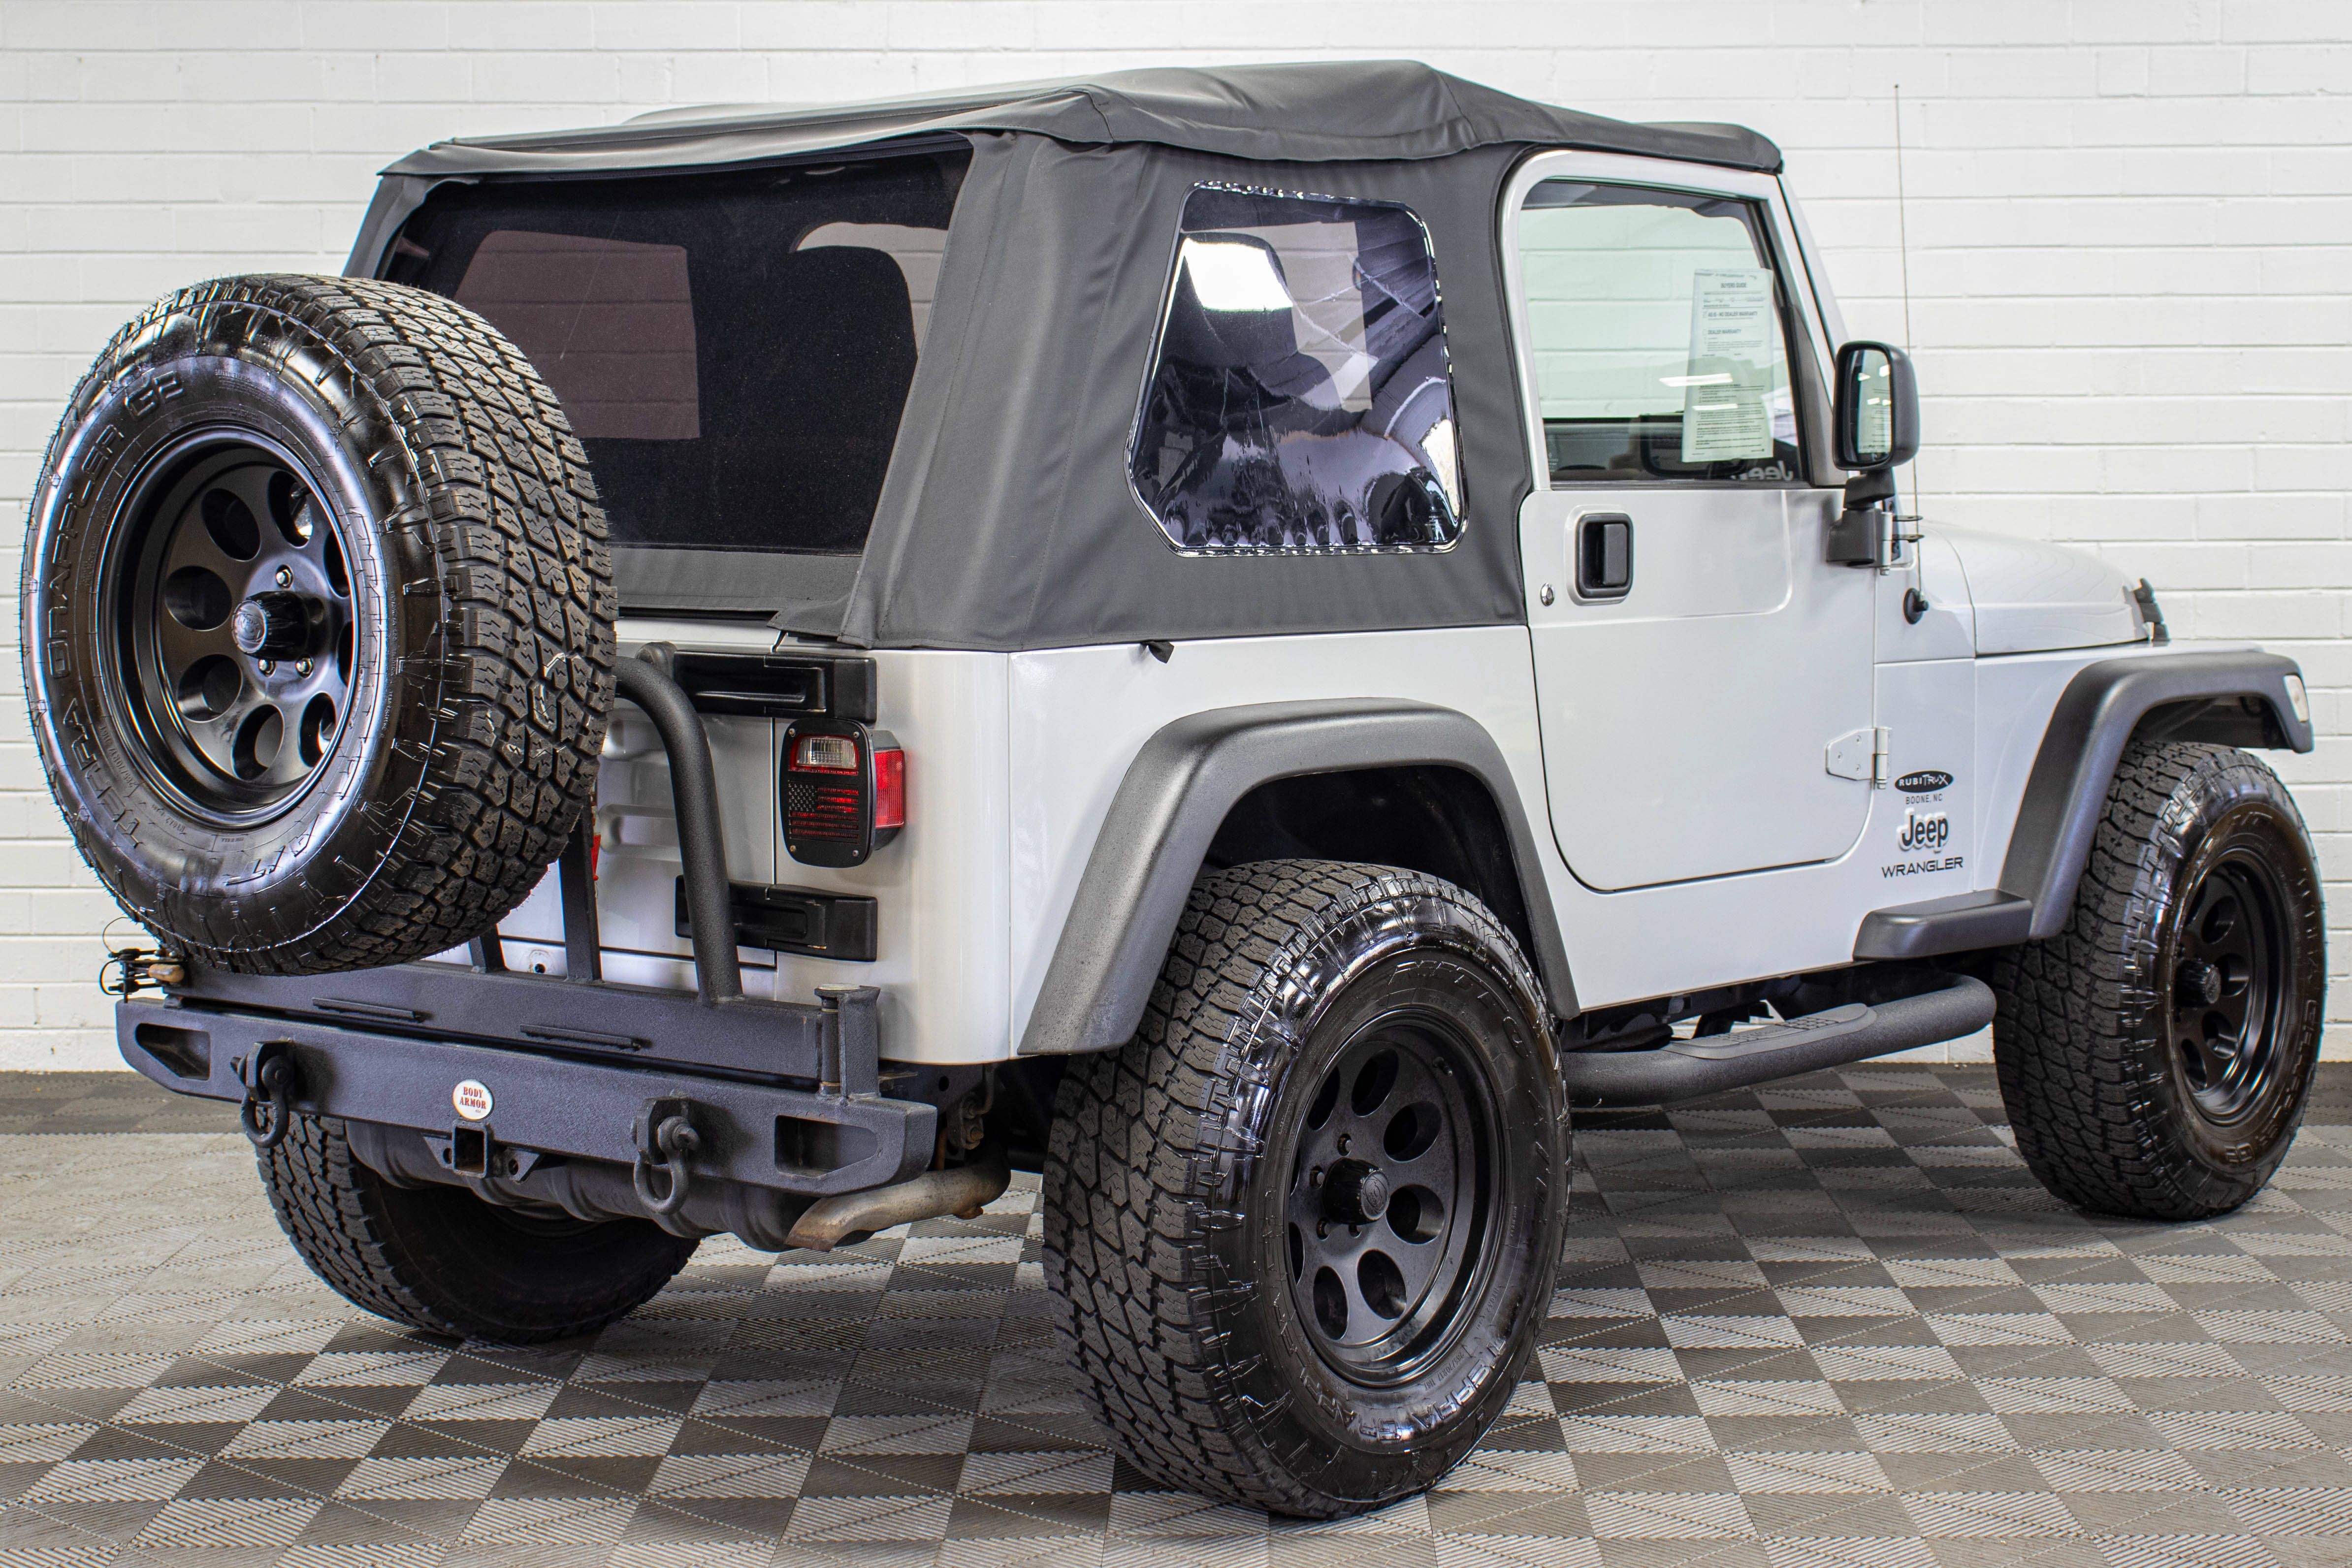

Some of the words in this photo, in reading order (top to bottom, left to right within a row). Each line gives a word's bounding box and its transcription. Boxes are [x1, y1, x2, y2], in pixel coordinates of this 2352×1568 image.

[1905, 794, 1932, 804] BOONE,
[1933, 793, 1943, 802] NC
[1900, 811, 1949, 849] Jeep
[1881, 857, 1964, 878] WRANGLER
[464, 1087, 483, 1098] BODY
[460, 1097, 486, 1109] ARMOR
